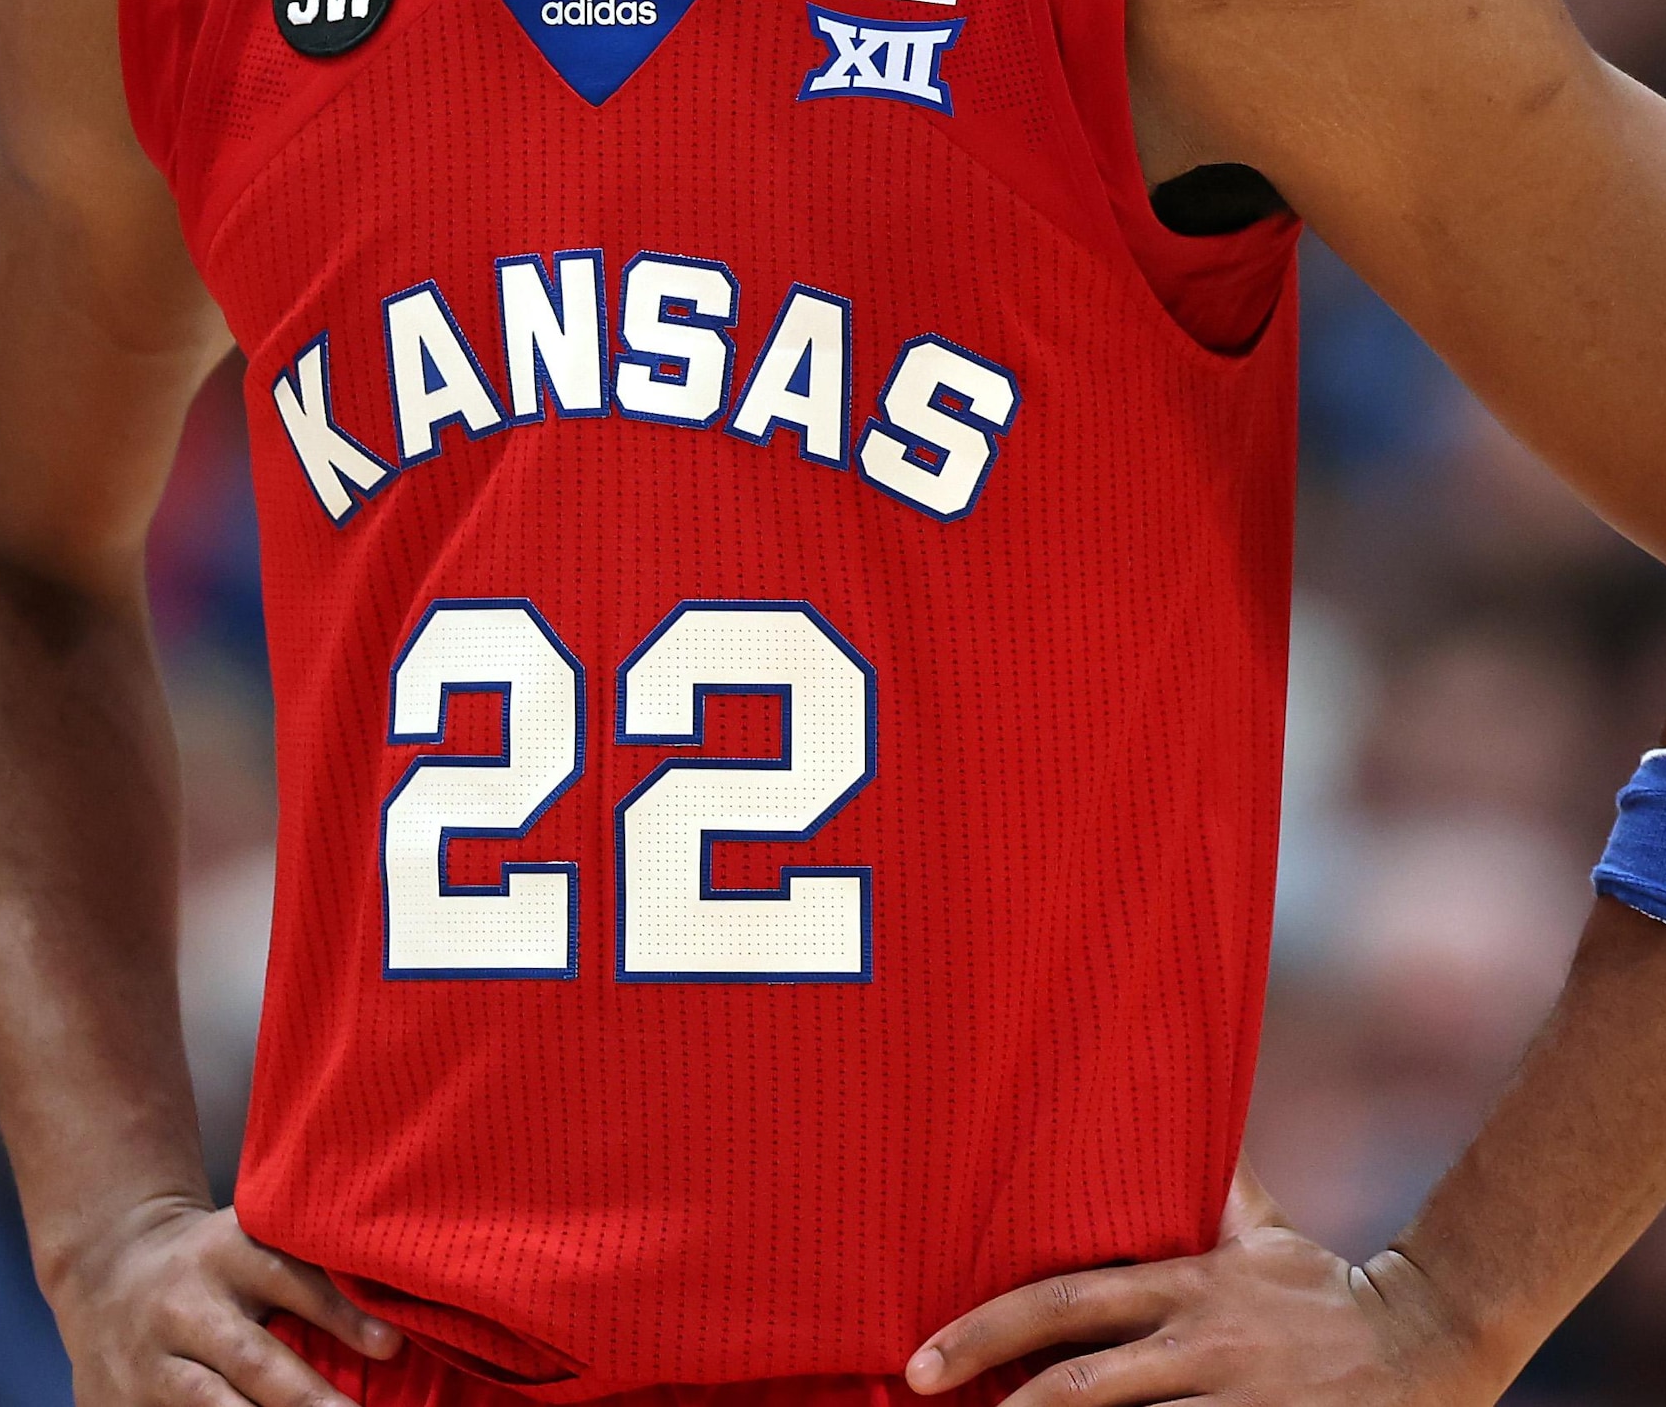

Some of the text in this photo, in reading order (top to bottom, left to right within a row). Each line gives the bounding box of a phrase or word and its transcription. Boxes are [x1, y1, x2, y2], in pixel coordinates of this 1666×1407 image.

[808, 15, 954, 104] XII
[273, 249, 1022, 528] KANSAS
[382, 599, 876, 982] 22
